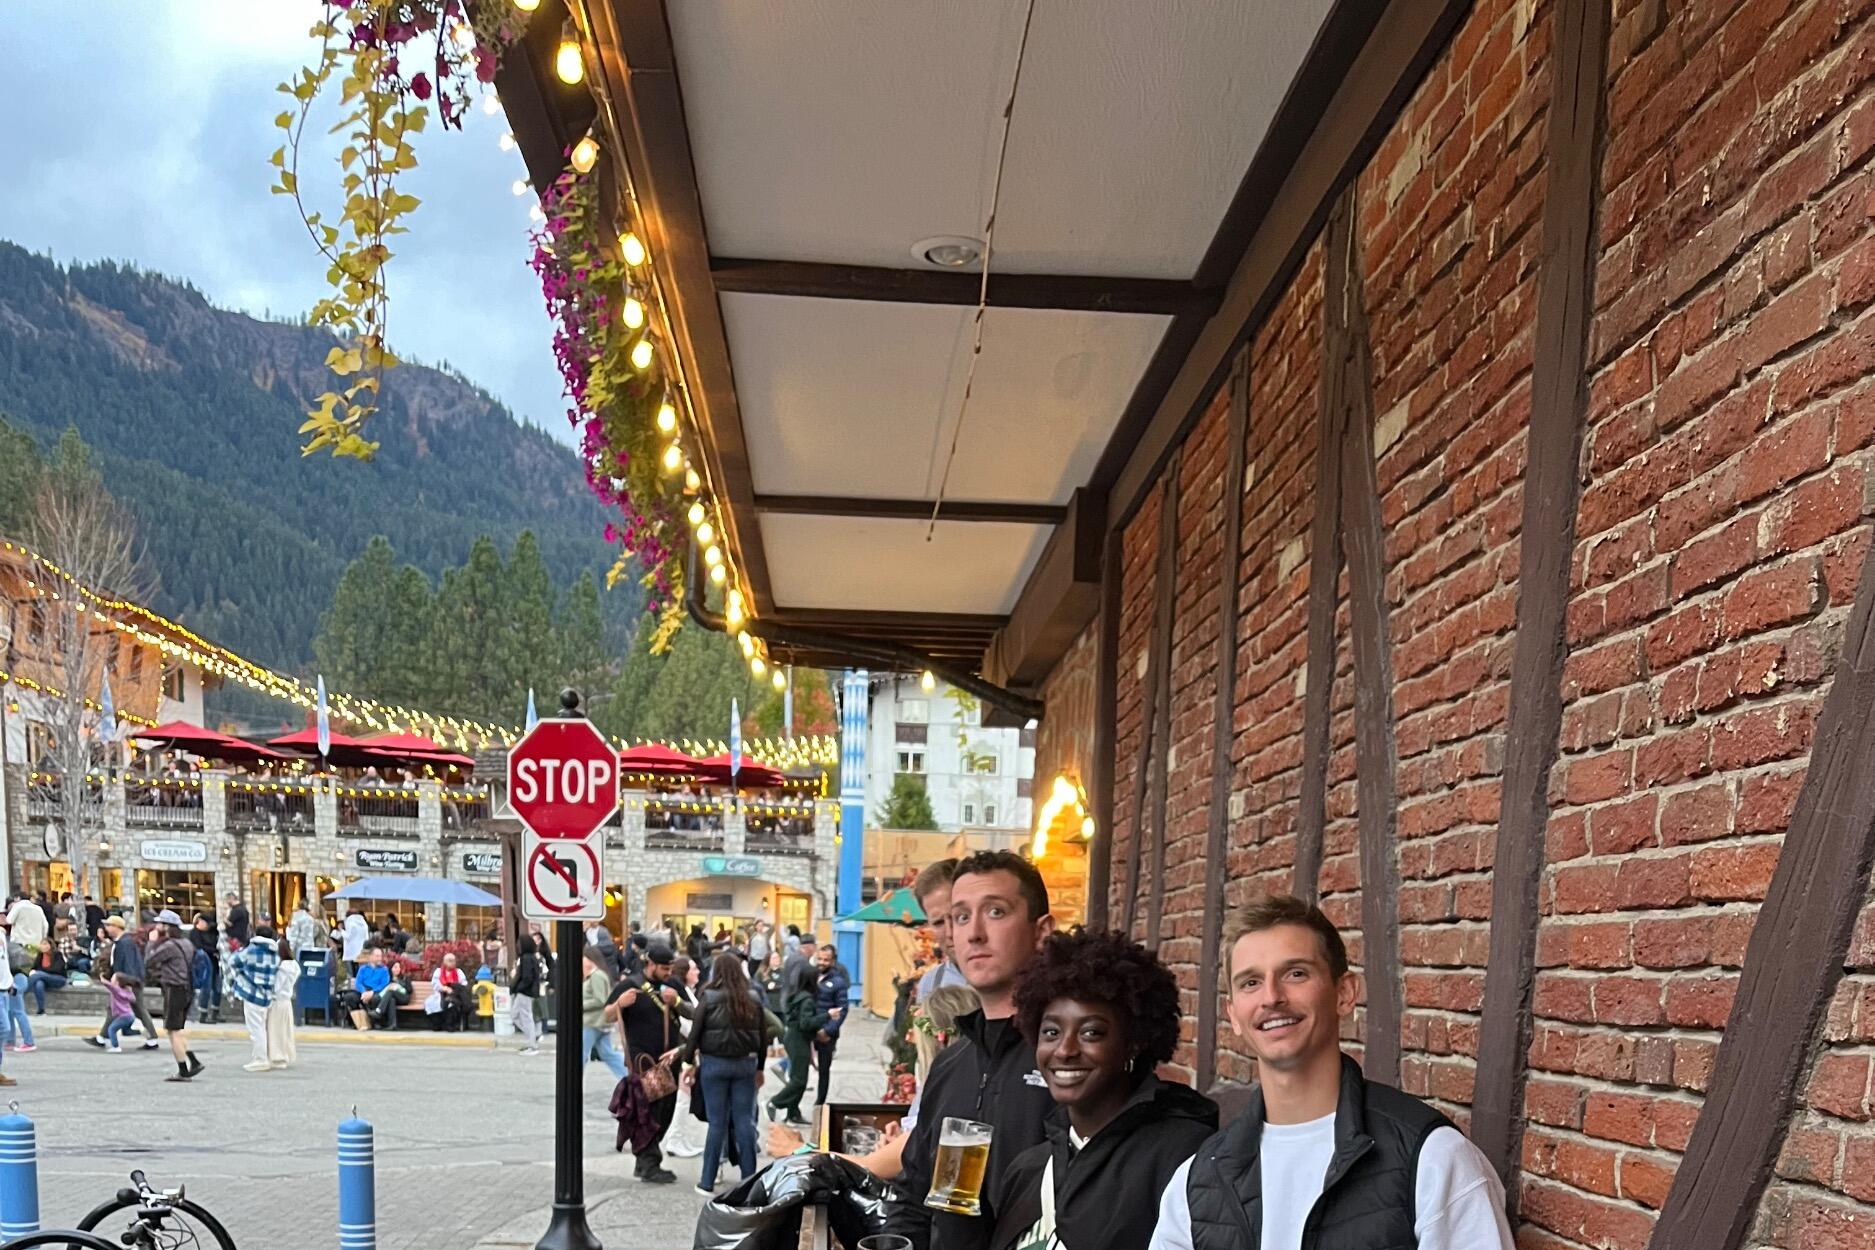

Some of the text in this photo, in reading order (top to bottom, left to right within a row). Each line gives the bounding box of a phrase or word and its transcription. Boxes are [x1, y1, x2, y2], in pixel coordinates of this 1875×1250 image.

[515, 758, 611, 803] STOP
[158, 848, 187, 857] CREAM
[382, 851, 414, 861] Patrick
